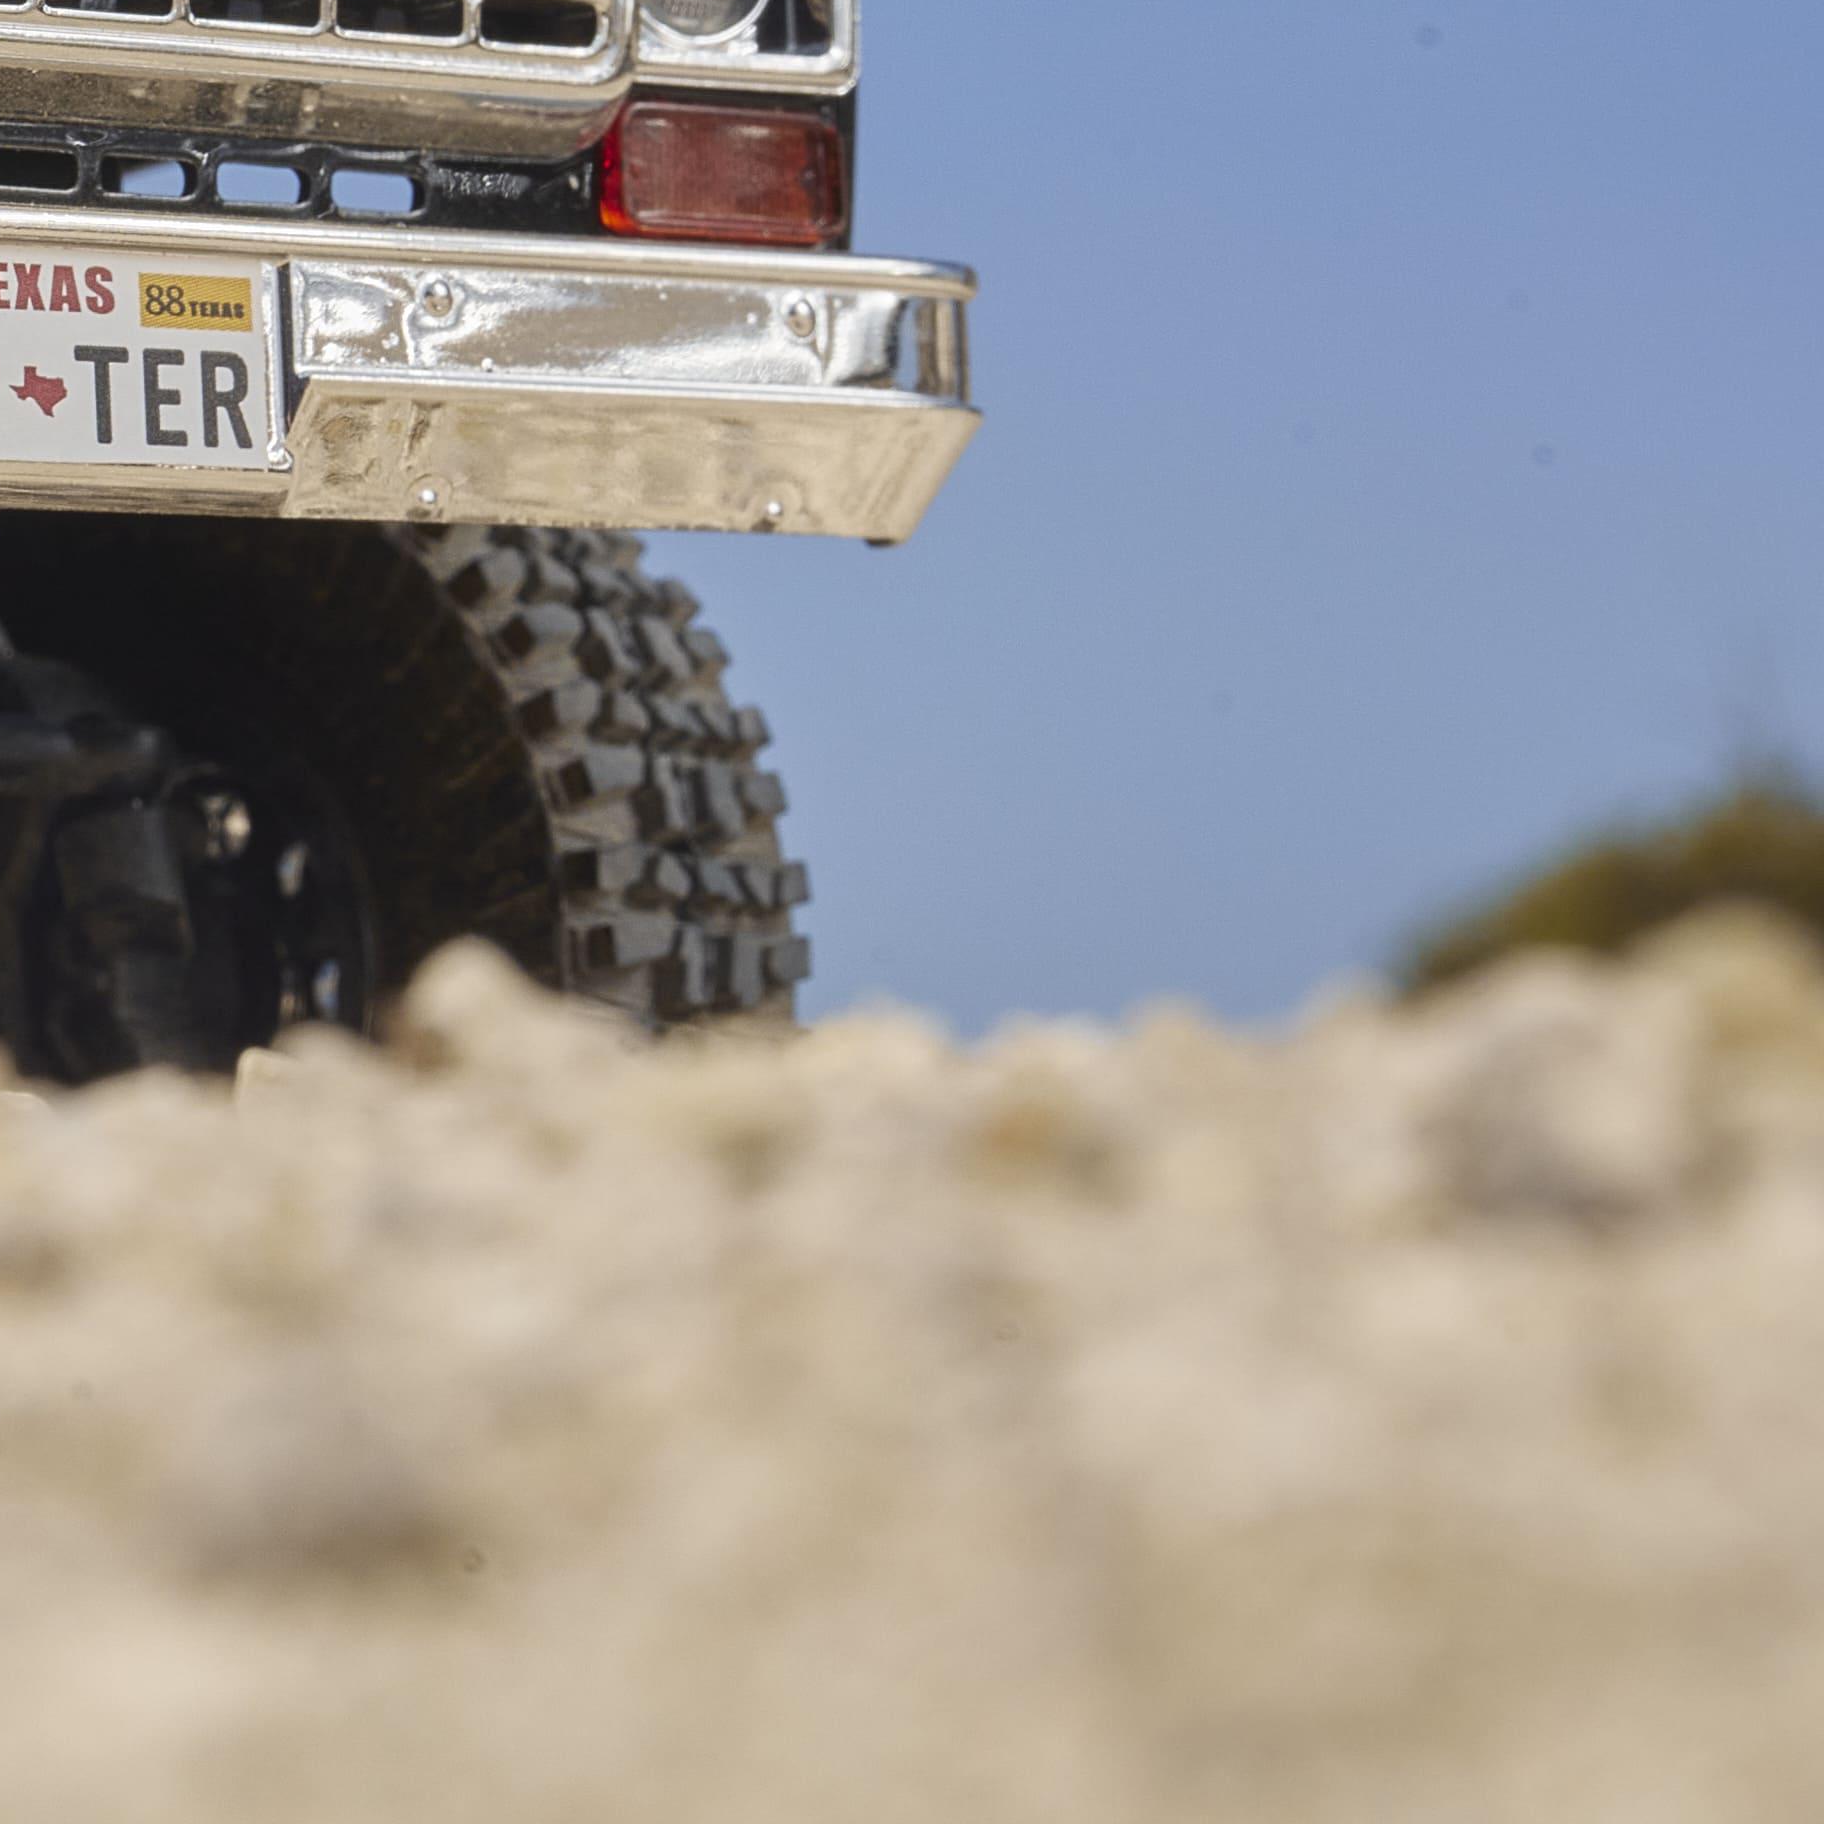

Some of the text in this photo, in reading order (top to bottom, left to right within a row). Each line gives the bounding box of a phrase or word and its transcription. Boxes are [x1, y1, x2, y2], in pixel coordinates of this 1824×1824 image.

[144, 284, 245, 318] 88 TEXAS
[74, 345, 253, 449] TER
